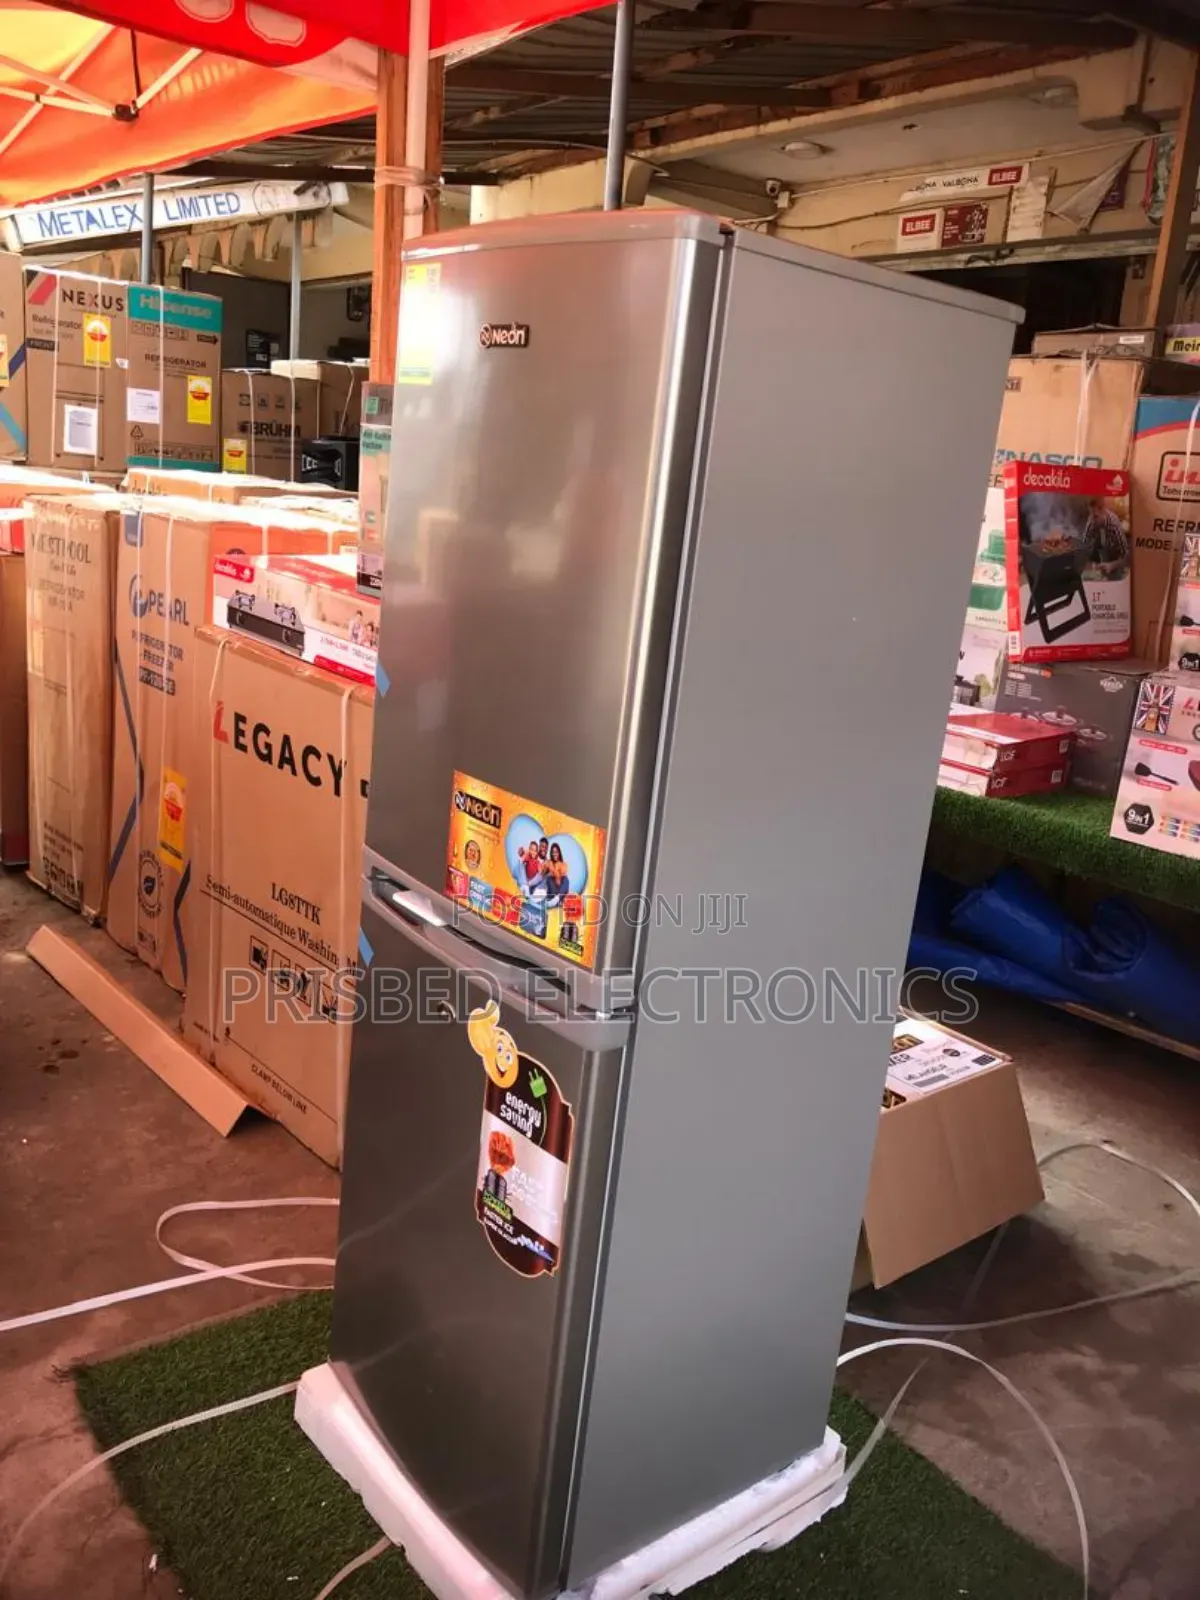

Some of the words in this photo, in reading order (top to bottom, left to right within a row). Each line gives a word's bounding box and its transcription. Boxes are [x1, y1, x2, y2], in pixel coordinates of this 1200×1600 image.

[37, 203, 143, 238] METALEX
[165, 192, 242, 222] LIMITED
[61, 288, 124, 312] NEXUS
[1023, 465, 1071, 488] decakila
[1135, 536, 1179, 552] MODE
[148, 588, 190, 627] PERL
[213, 700, 347, 797] LEGACY
[465, 796, 501, 827] Neon
[205, 873, 297, 940] Semi-automatique
[297, 926, 340, 967] Washin
[500, 1104, 533, 1139] saving
[505, 1091, 542, 1127] energy
